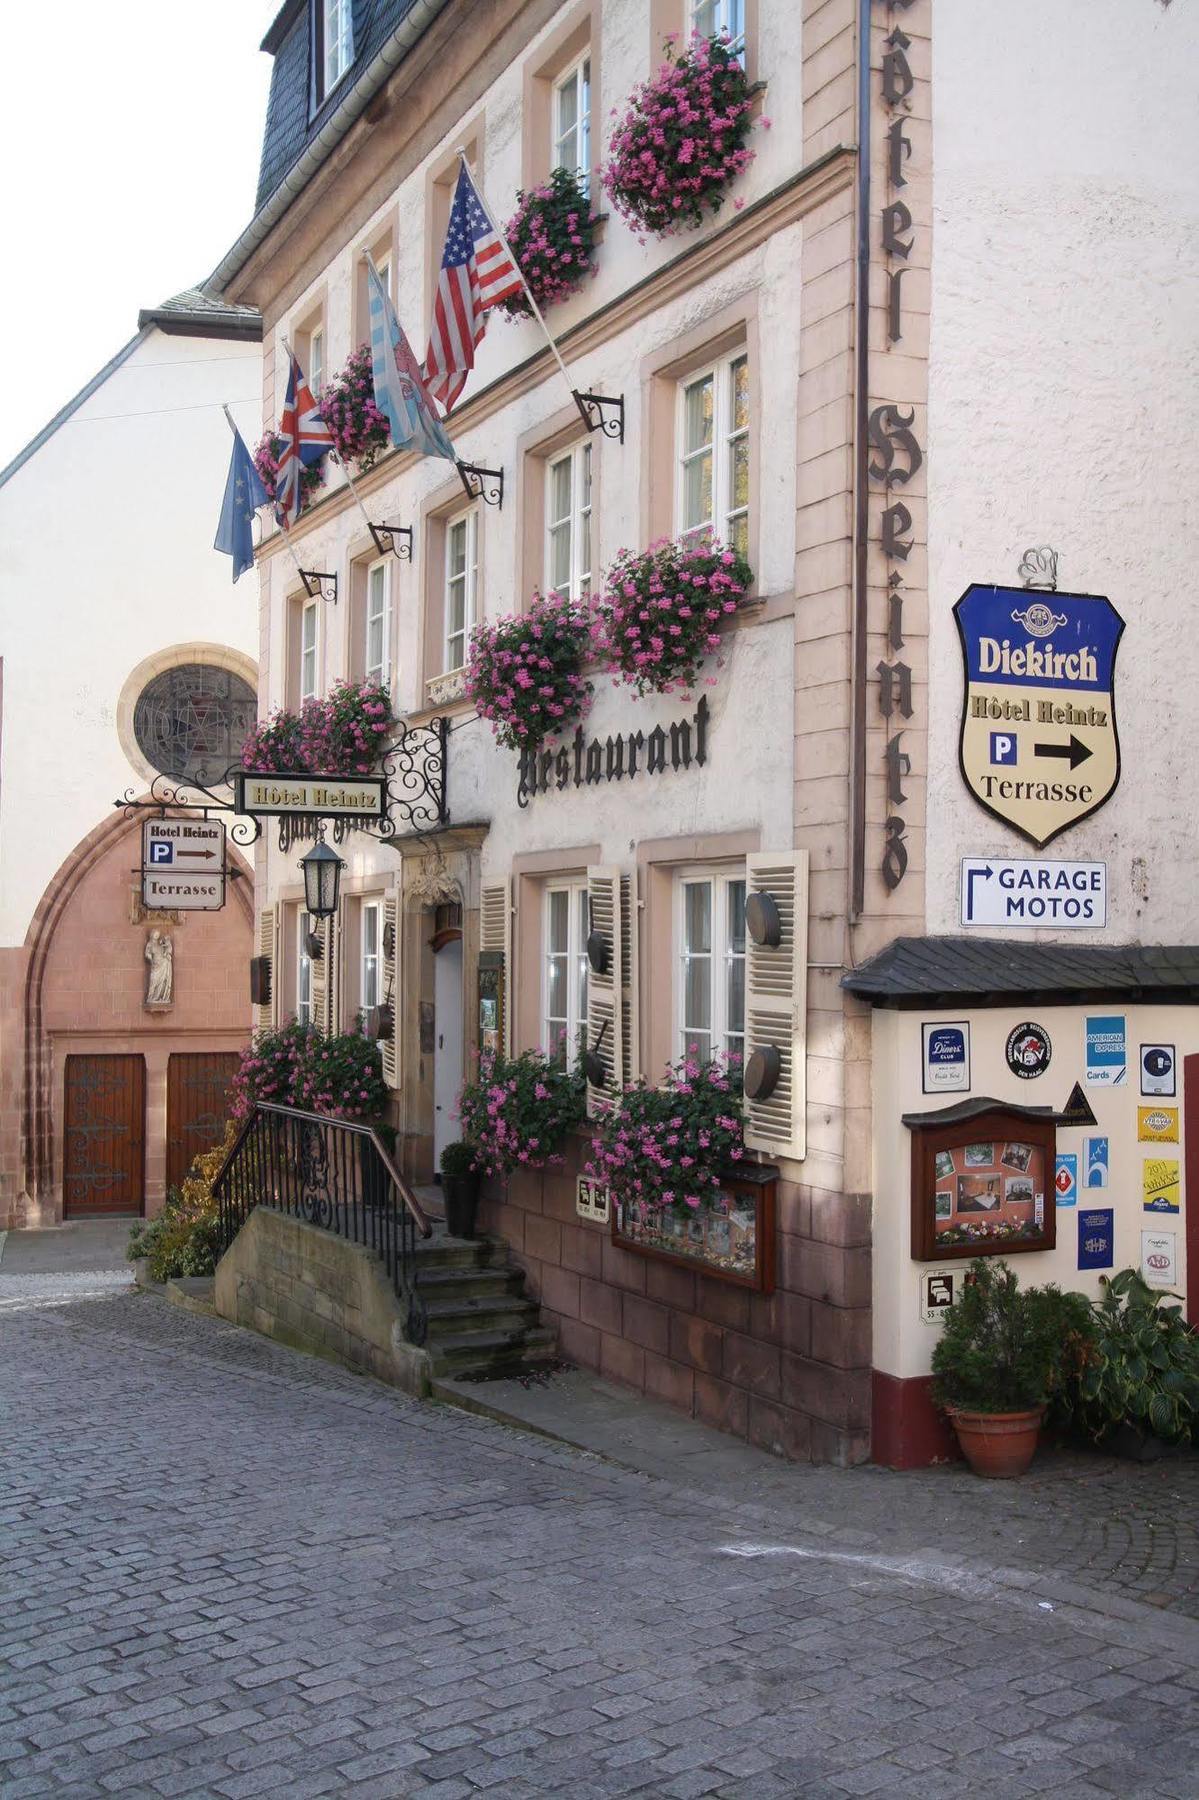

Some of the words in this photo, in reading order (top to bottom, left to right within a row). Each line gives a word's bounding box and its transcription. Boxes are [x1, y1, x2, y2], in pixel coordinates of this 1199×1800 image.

[880, 0, 916, 345] ôtel
[868, 404, 922, 890] Heintz
[978, 637, 1098, 682] Diekirch
[971, 695, 1031, 722] Hôtel
[1037, 699, 1108, 727] Heintz
[995, 736, 1012, 761] P
[252, 786, 307, 806] Hôtel
[313, 788, 377, 808] Heintz
[980, 775, 1093, 804] Terrasse
[183, 827, 219, 839] Heintz
[153, 844, 170, 863] P
[150, 881, 217, 896] Terrasse
[998, 868, 1101, 891] GARAGE
[1006, 897, 1093, 918] MOTOS
[1087, 1033, 1123, 1043] AMERICAN
[1095, 1043, 1126, 1053] EXPRESS
[1087, 1071, 1110, 1080] Cards
